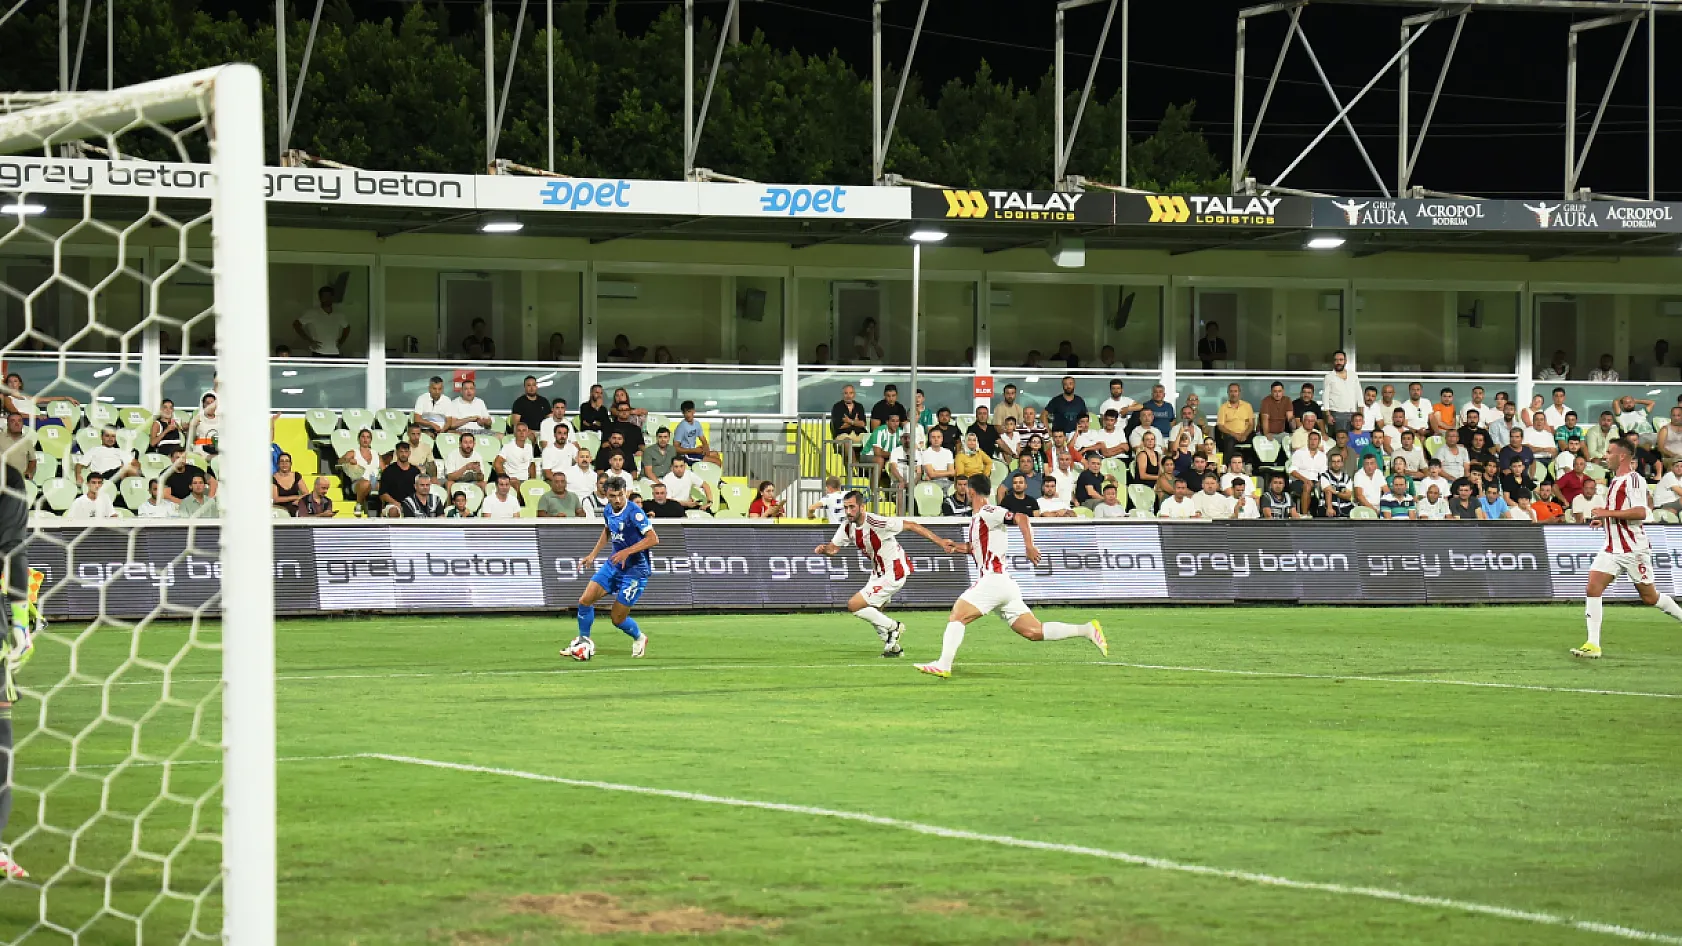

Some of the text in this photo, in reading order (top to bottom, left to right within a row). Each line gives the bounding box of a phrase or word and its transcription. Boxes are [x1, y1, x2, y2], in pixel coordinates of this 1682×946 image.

[354, 171, 461, 198] beton
[988, 192, 1083, 212] TALAY
[1190, 196, 1282, 215] TALAY
[1373, 201, 1396, 210] GRUP
[1563, 203, 1586, 213] GRUP
[995, 211, 1075, 221] LOGISTICS
[1362, 210, 1409, 225] AURA
[1416, 203, 1485, 218] ACROPOL
[1606, 206, 1672, 220] ACROPOL
[1196, 216, 1275, 224] LOGISTICS
[1433, 218, 1468, 226] BODRUM
[1552, 212, 1599, 227] AURA
[1622, 220, 1657, 228] BODRUM
[1063, 549, 1156, 570] beton
[1176, 549, 1348, 577] grey beton
[1367, 549, 1537, 577] grey beton
[79, 562, 174, 587] grey
[327, 553, 531, 583] grey beton
[768, 557, 849, 579] grey
[1638, 563, 1647, 574] 6
